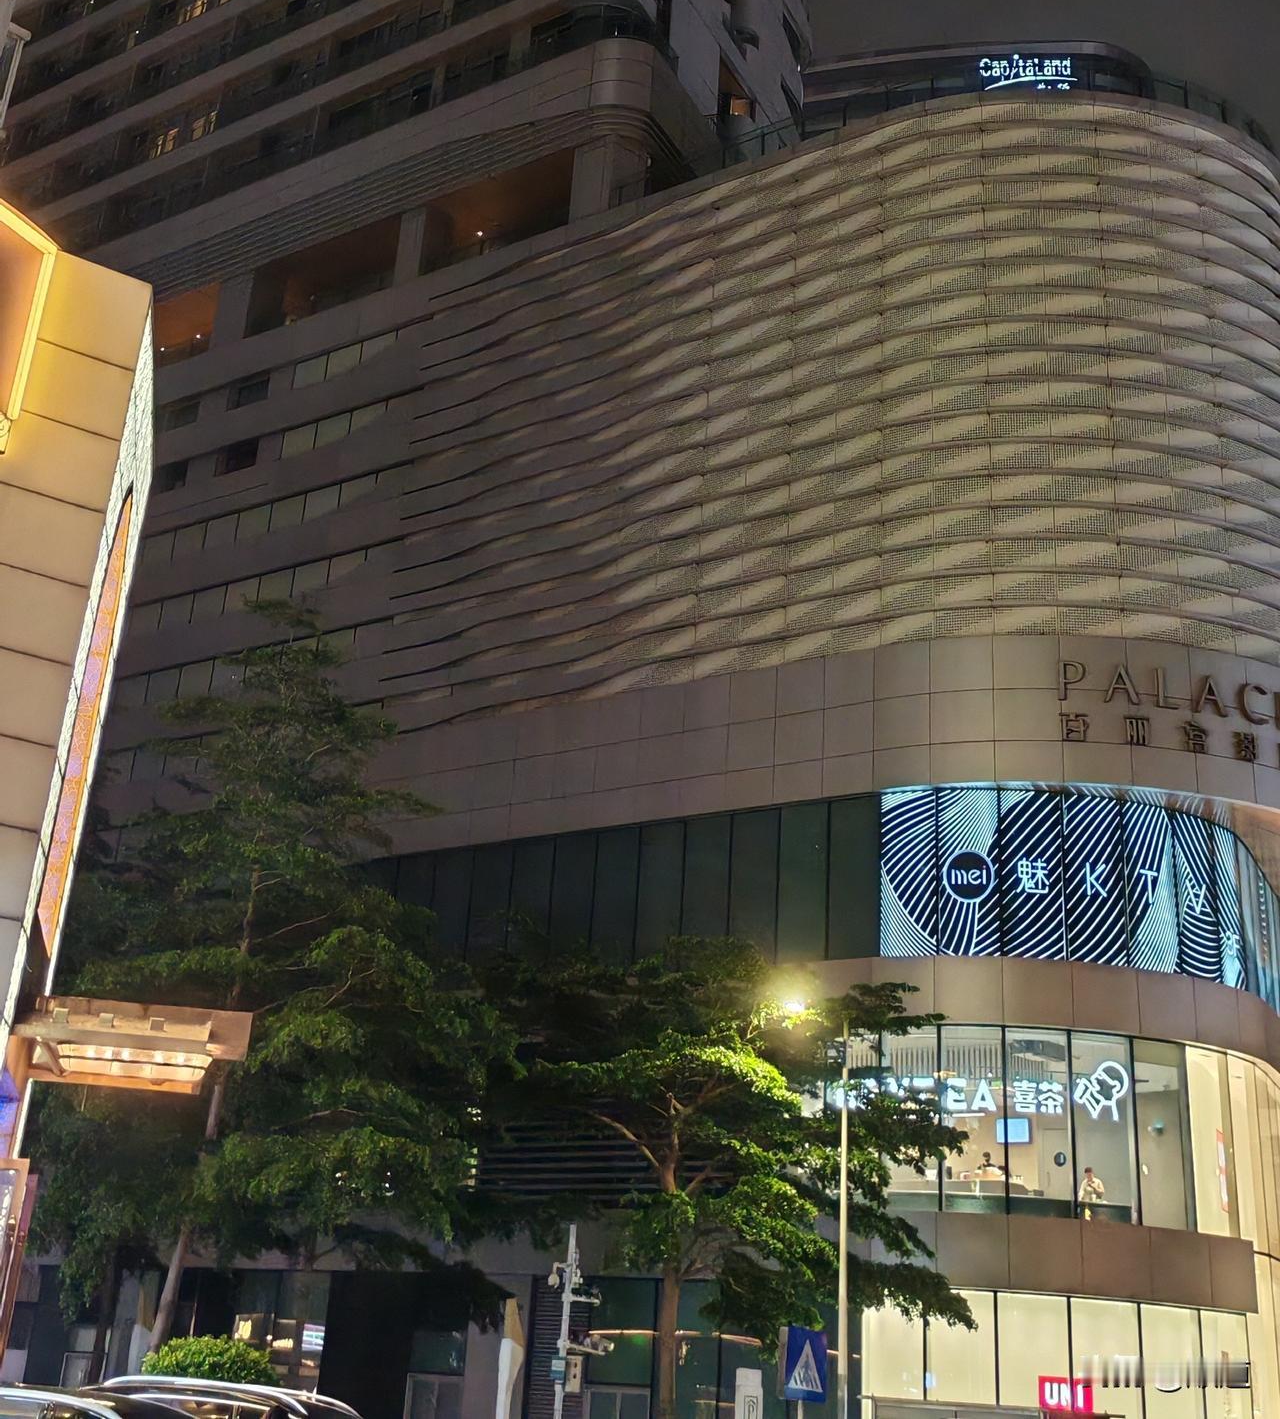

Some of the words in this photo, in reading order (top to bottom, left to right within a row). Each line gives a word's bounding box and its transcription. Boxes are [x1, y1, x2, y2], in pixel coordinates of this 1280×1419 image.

[979, 54, 1071, 82] CapitaLand
[1058, 660, 1280, 730] PALAC
[1059, 712, 1280, 769] 百丽宫影
[951, 865, 987, 885] mei
[1013, 1080, 1065, 1114] 喜茶
